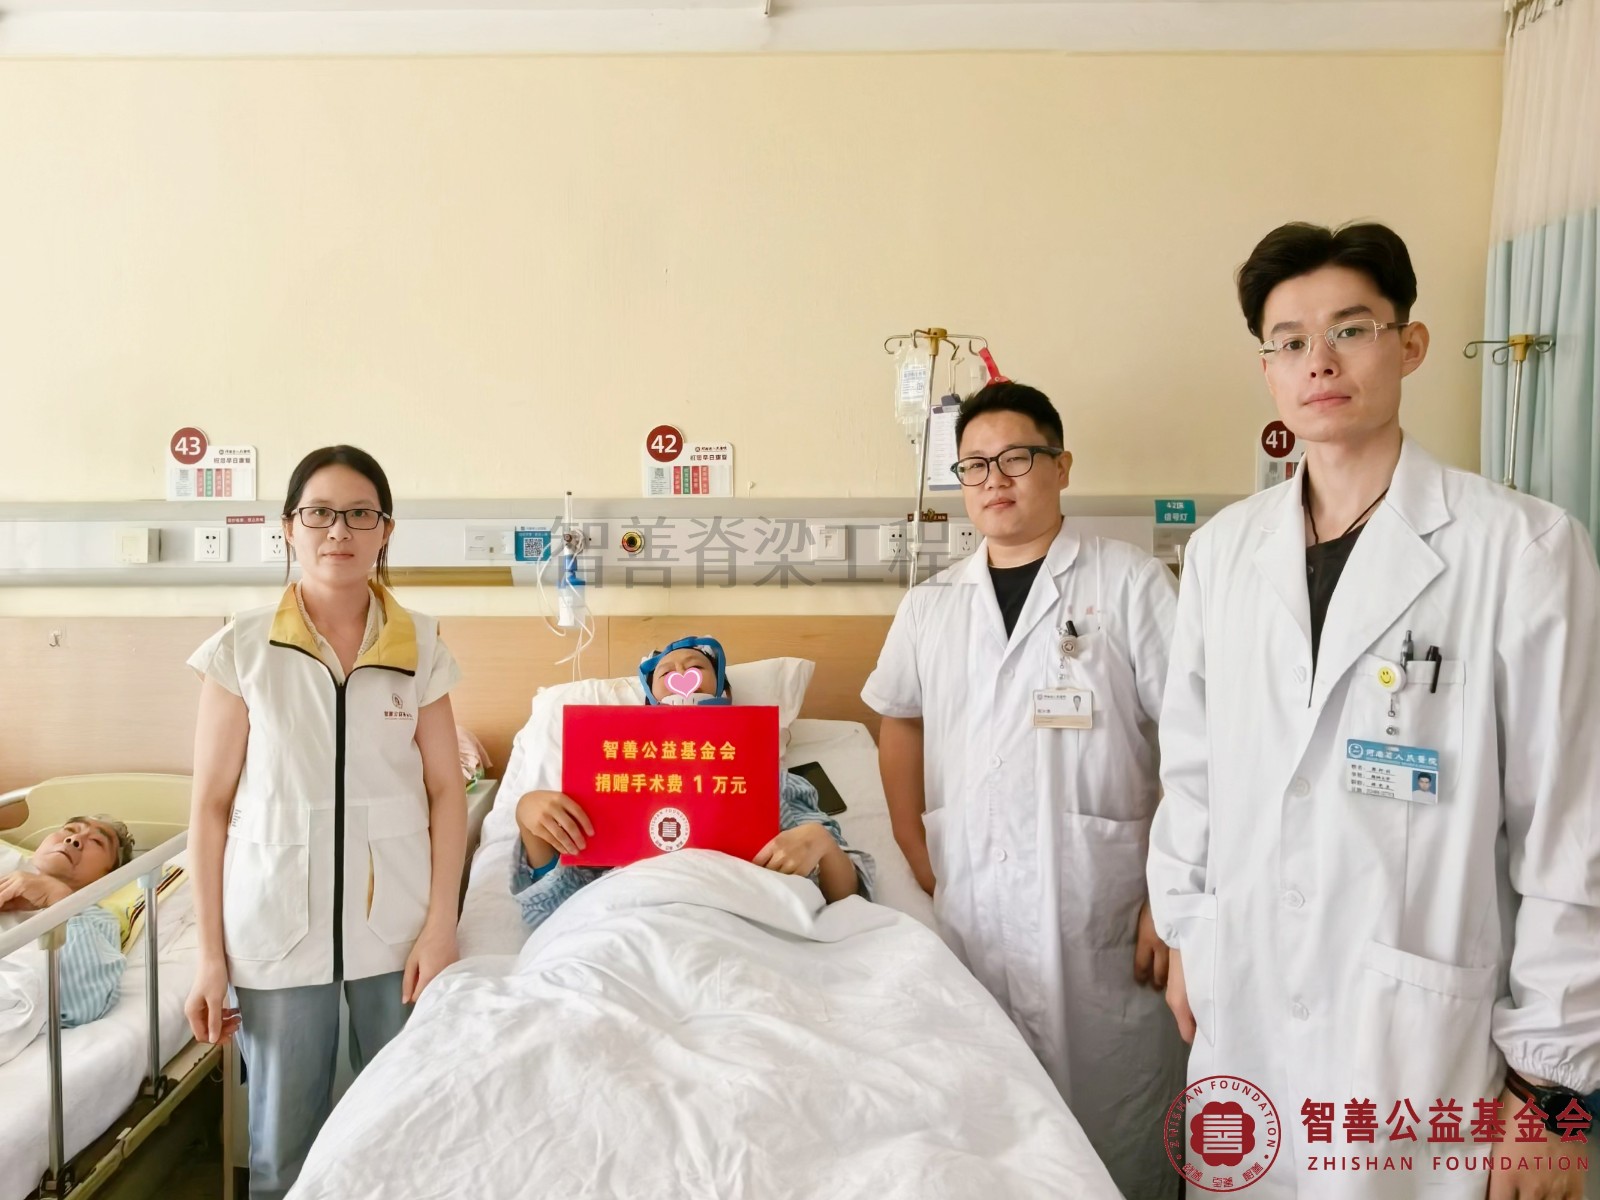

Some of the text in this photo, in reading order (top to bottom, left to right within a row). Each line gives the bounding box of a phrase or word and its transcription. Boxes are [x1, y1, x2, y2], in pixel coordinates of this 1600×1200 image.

[174, 436, 201, 456] 43
[651, 434, 677, 453] 42
[1265, 430, 1287, 449] 41
[603, 740, 736, 760] 智善公益基金会
[595, 773, 747, 794] 捐赠手术费 1 万元
